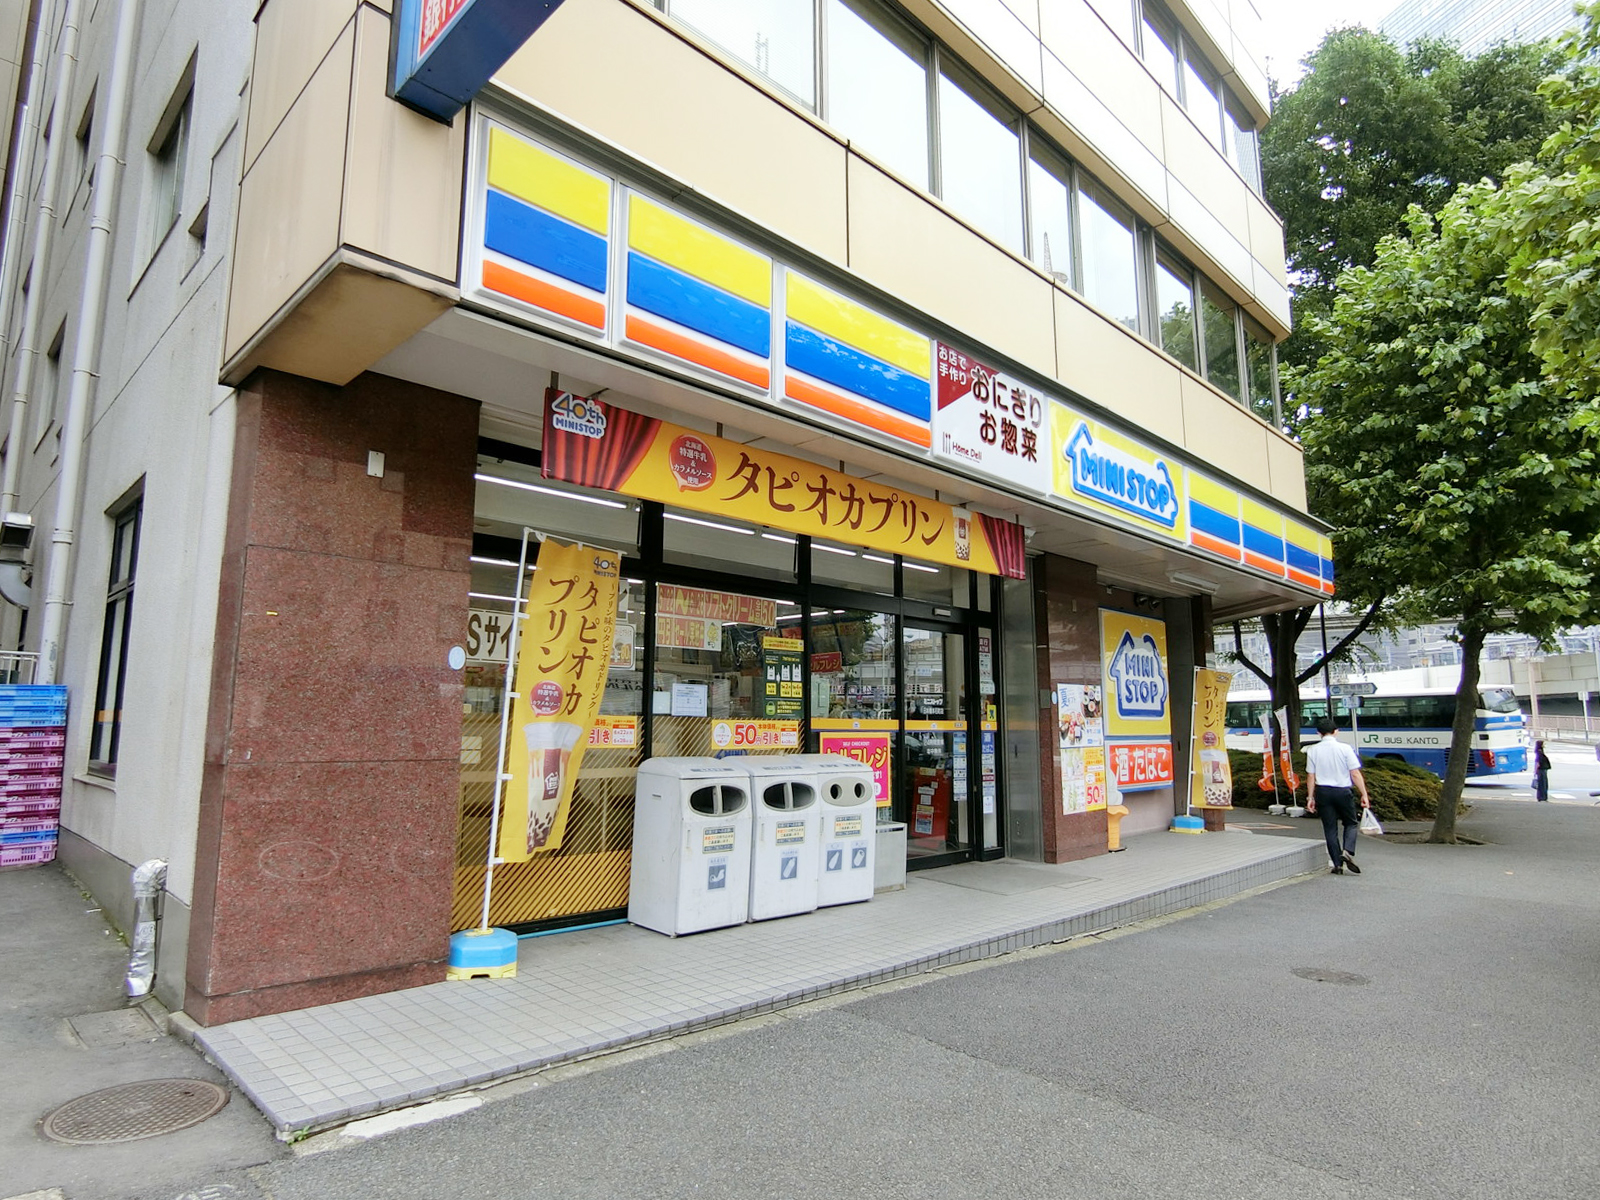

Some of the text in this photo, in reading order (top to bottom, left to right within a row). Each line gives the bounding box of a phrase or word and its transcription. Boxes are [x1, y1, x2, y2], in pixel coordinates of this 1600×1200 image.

[939, 346, 967, 370] お店で
[939, 362, 967, 386] 手作り
[554, 394, 605, 426] 40th
[972, 367, 1042, 429] おにぎり
[555, 417, 602, 436] MINISTOP
[979, 409, 1038, 463] お惣菜
[952, 441, 970, 456] Home
[970, 448, 982, 461] Deli
[673, 463, 713, 479] カラメルソース
[719, 451, 945, 546] タピオカプリン
[538, 574, 580, 674] プリン
[558, 580, 601, 716] タピオカ
[1124, 652, 1154, 678] MINI
[1124, 680, 1159, 704] STOP
[1363, 734, 1379, 743] JR
[1406, 737, 1439, 745] KANTO
